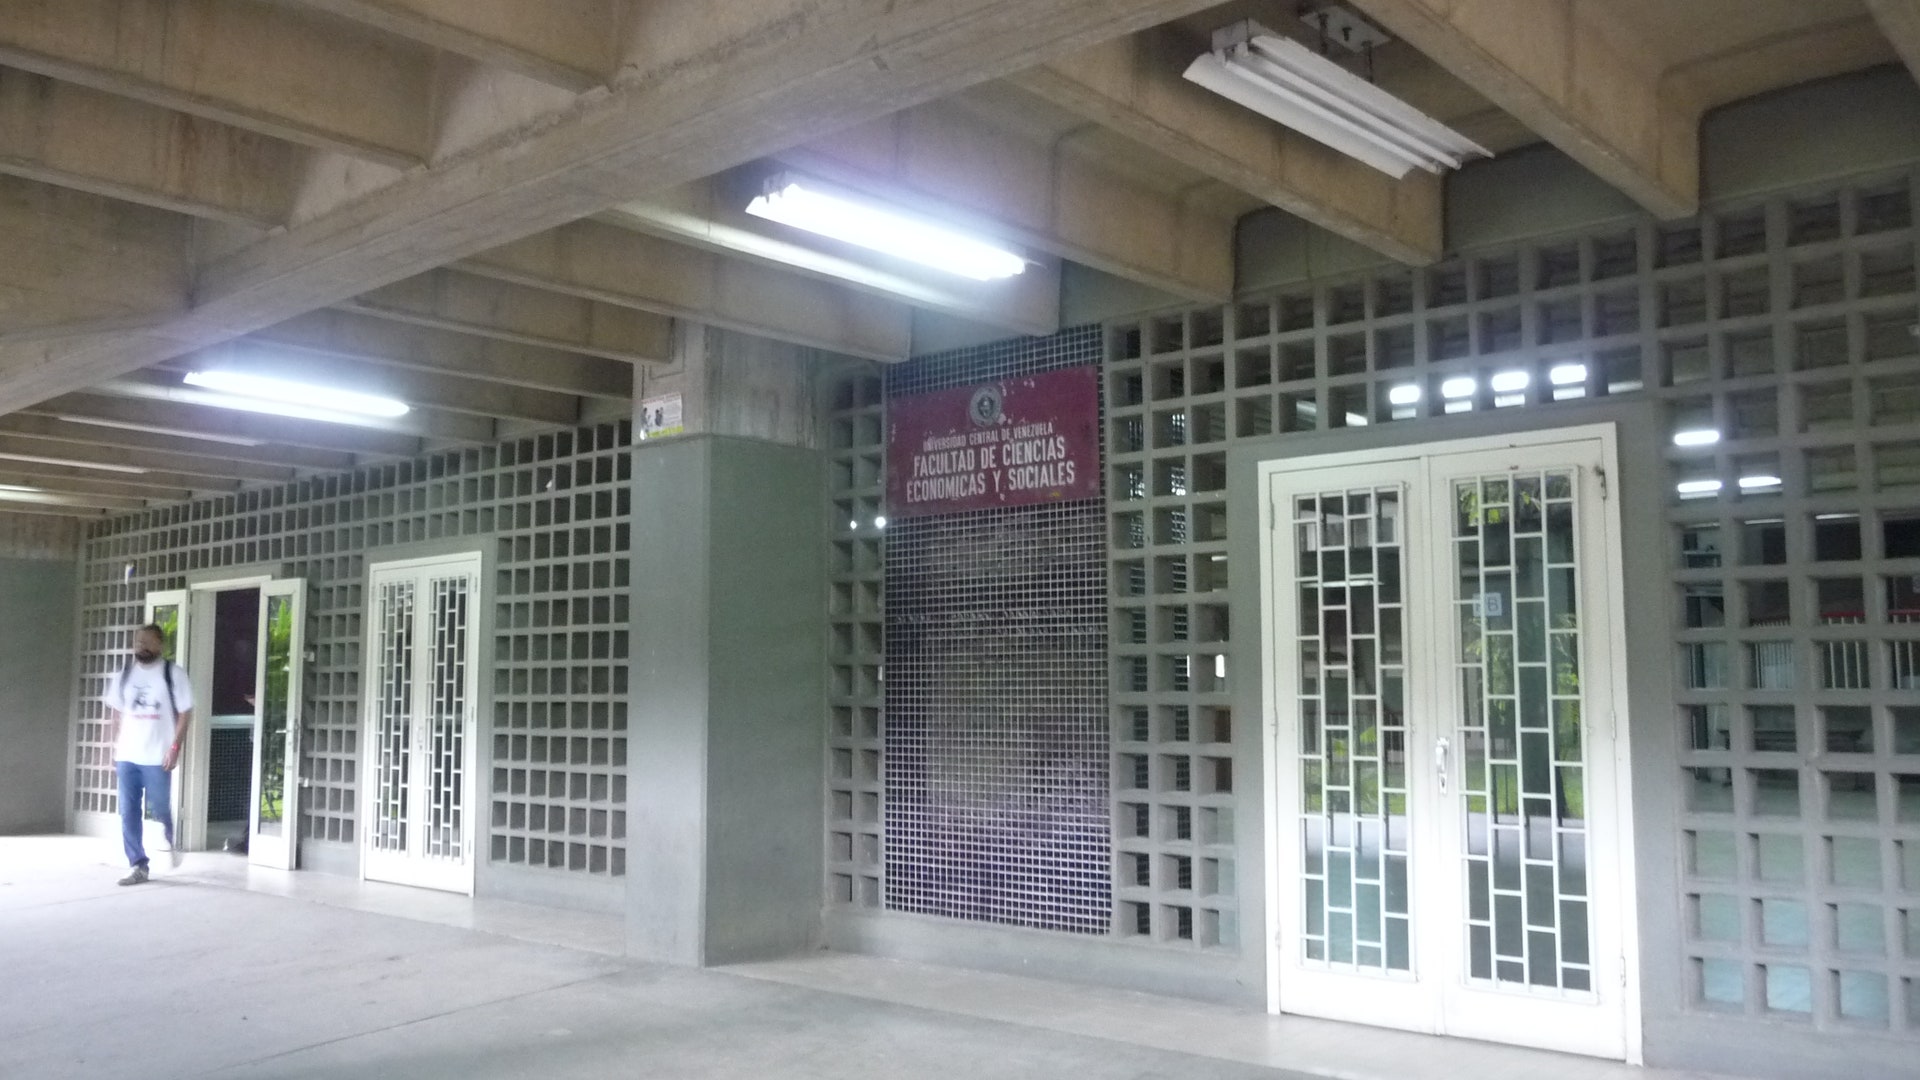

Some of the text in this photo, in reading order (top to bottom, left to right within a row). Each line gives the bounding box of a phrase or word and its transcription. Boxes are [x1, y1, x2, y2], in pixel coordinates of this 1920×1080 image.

[913, 436, 1066, 477] FACULTAD DE CIENCIAS
[923, 422, 1053, 452] UNIVERSIDAD CENTRAL DE VENEZUELA
[906, 461, 1075, 503] ECONOMICAS Y SOCIALES
